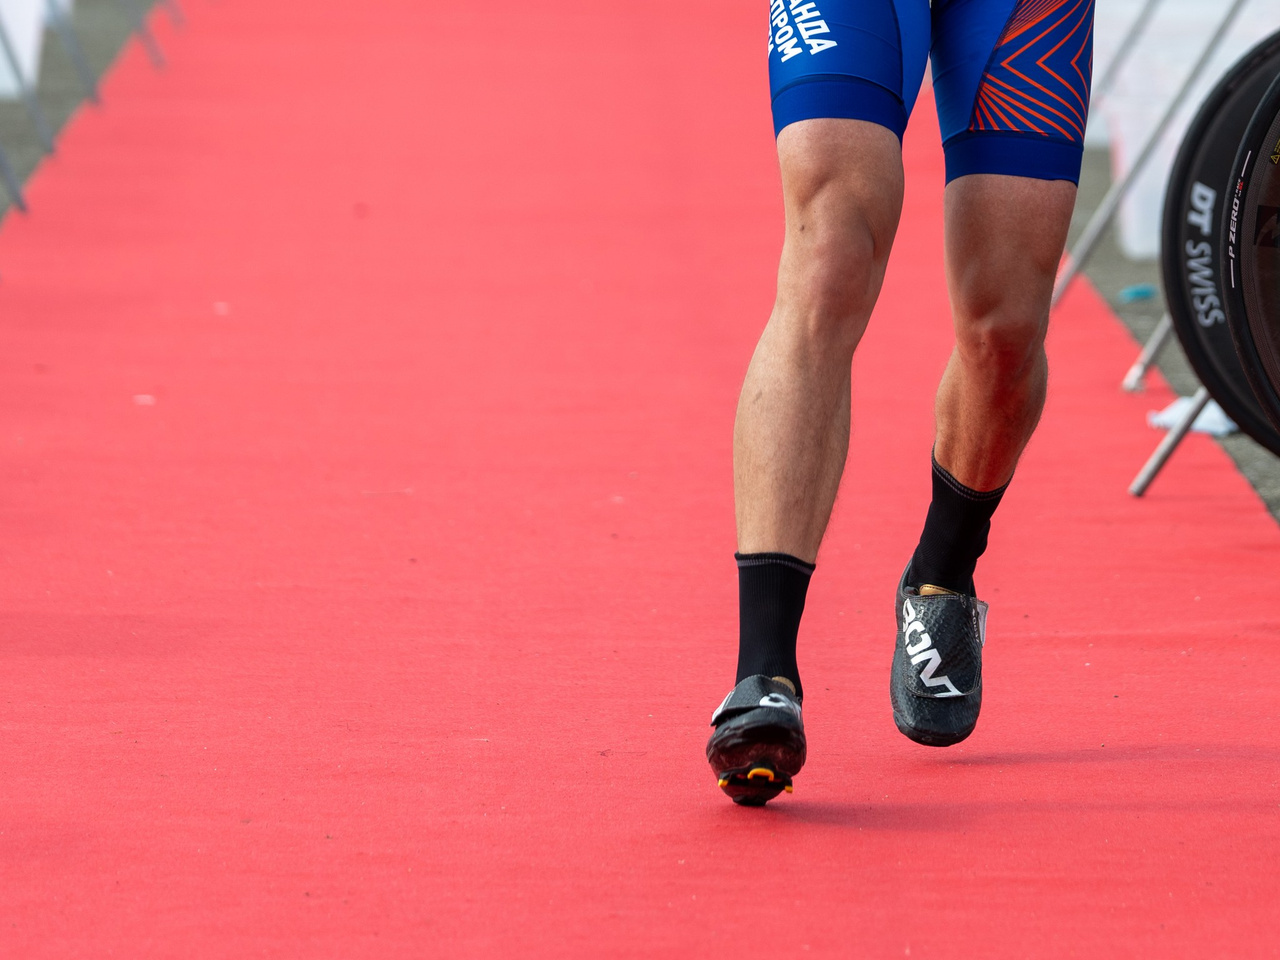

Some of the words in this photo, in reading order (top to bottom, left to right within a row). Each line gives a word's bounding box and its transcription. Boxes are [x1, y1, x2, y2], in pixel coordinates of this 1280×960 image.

[1187, 180, 1217, 237] DT
[1228, 197, 1240, 245] ZERO
[1228, 245, 1235, 259] P
[1185, 239, 1225, 328] SWISS
